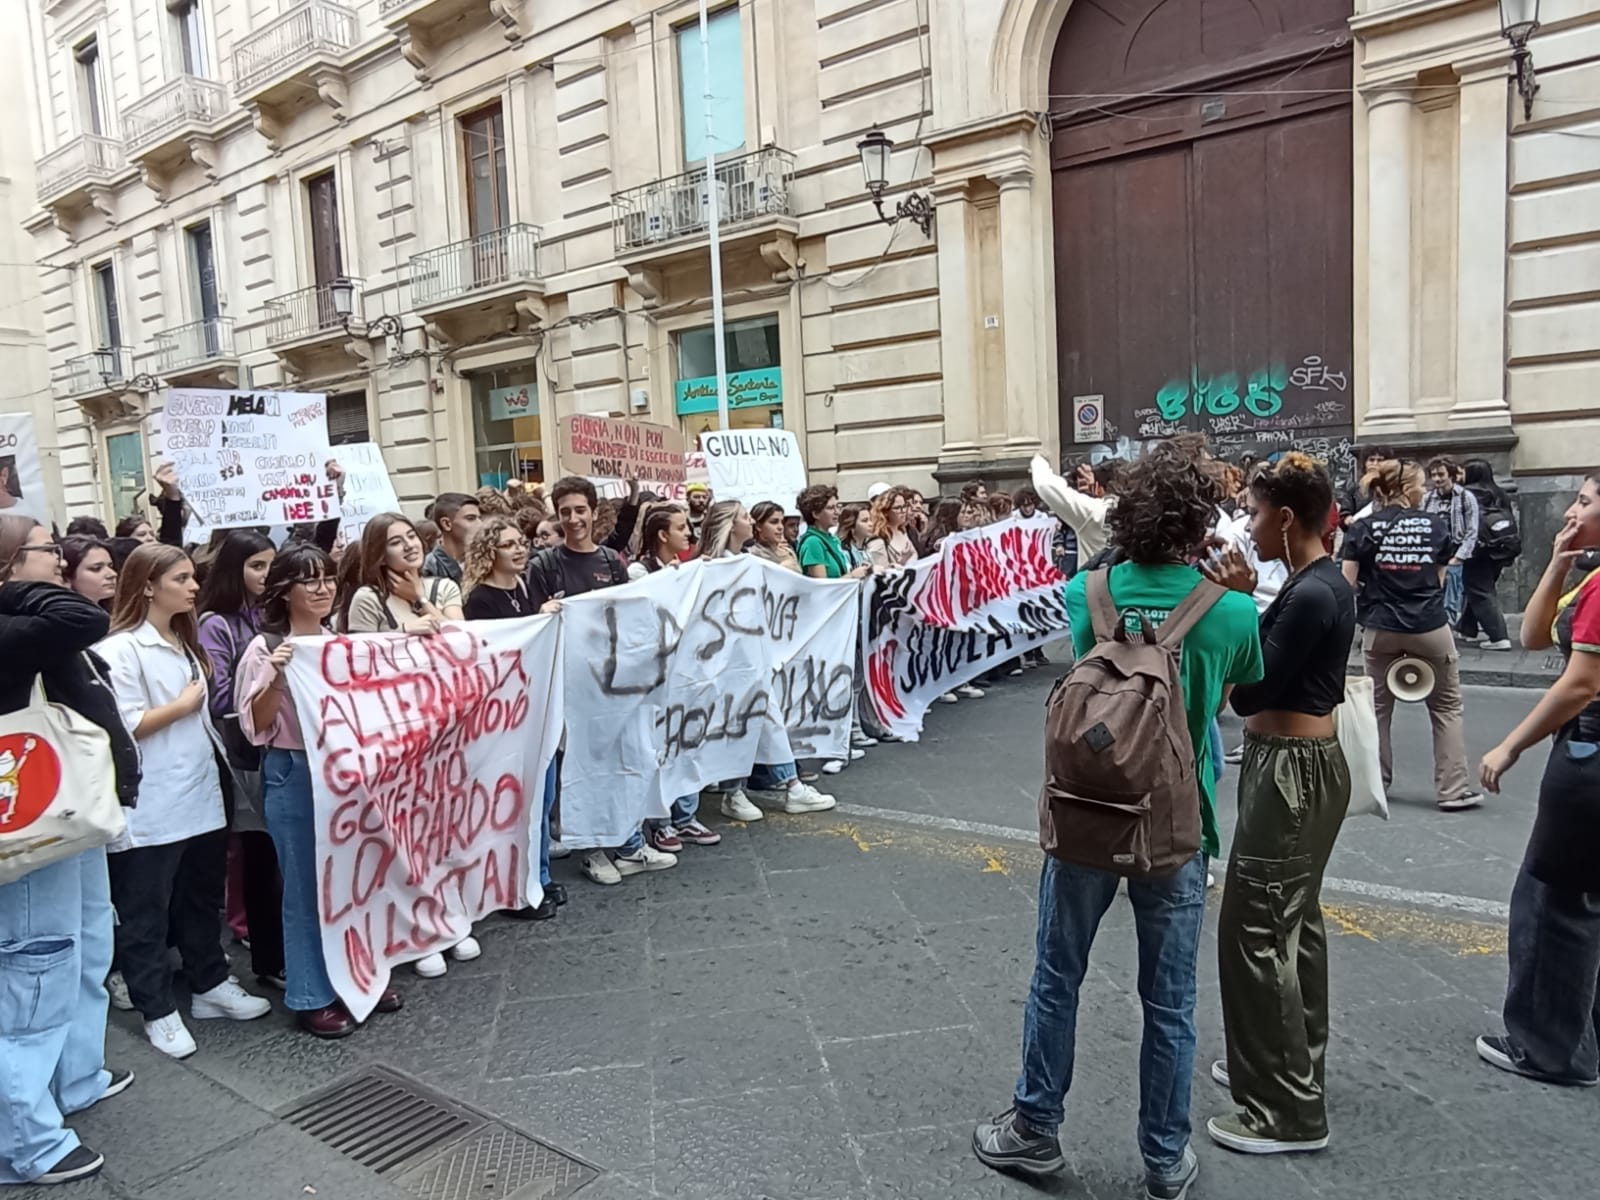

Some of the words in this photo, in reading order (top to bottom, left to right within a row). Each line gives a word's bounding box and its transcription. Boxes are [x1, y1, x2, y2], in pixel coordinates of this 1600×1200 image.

[615, 425, 640, 445] NON
[706, 435, 790, 458] GIULIANO
[591, 459, 622, 478] MADRE
[317, 485, 334, 498] LE
[283, 502, 315, 521] IDEE
[1375, 553, 1434, 564] PAURA
